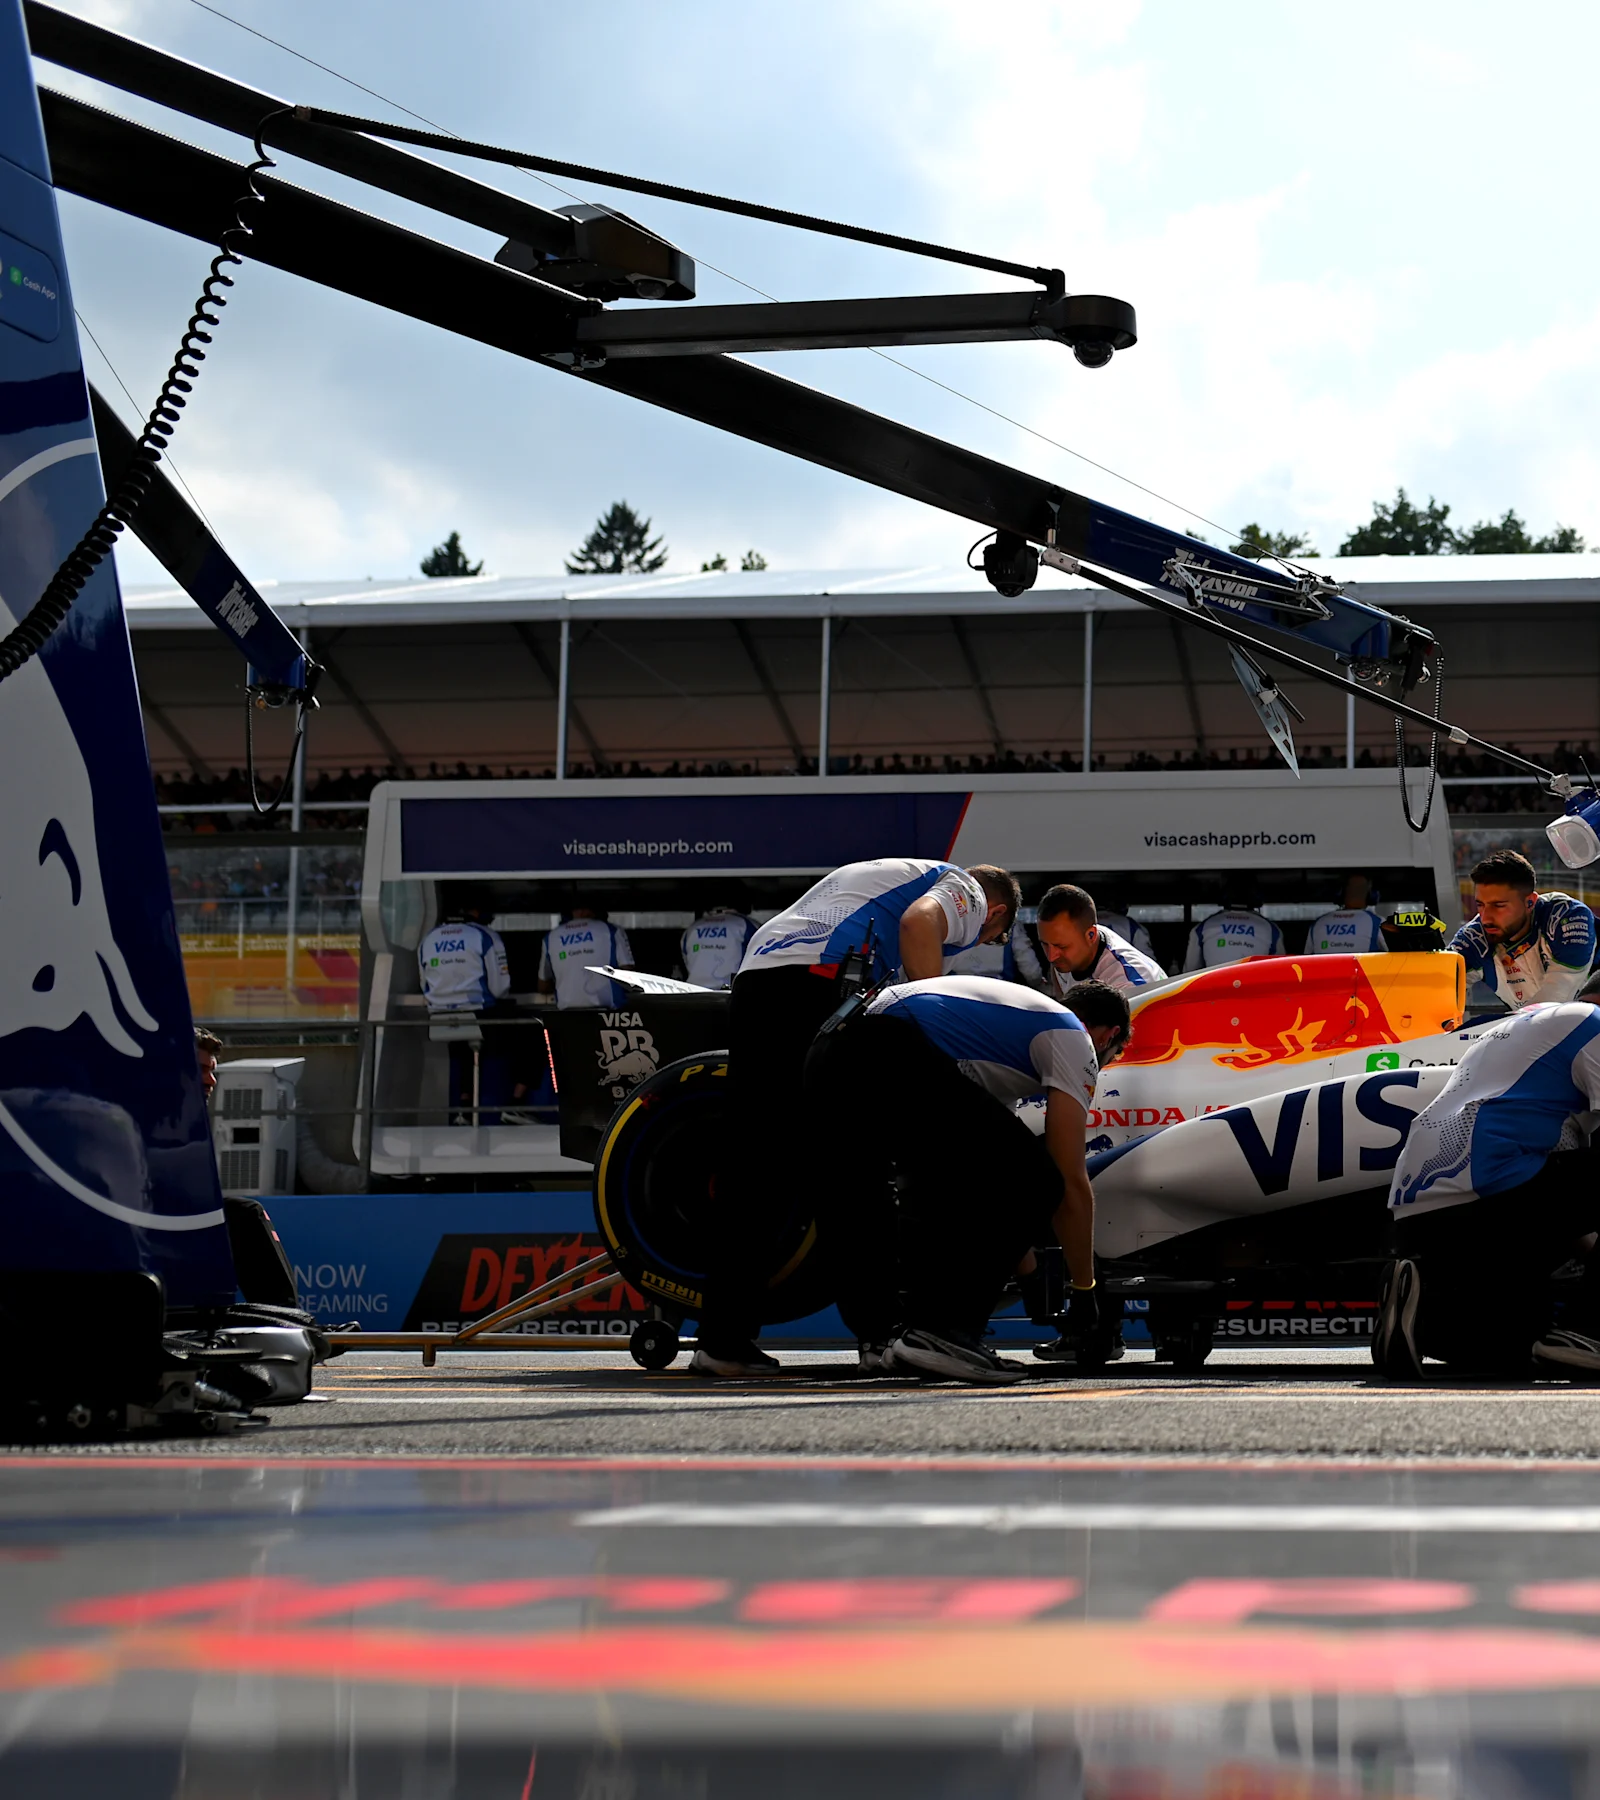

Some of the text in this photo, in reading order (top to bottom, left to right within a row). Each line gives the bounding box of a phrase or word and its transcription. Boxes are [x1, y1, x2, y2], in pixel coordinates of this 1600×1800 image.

[23, 276, 41, 292] Cash
[563, 839, 734, 857] visacashapprb.com
[1144, 832, 1316, 848] visacashapprb.com
[1396, 913, 1426, 925] LAW
[697, 927, 727, 938] VISA
[1221, 924, 1255, 937] VISA
[1325, 924, 1356, 935] VISA
[435, 940, 465, 953] VISA
[560, 931, 593, 946] VISA
[598, 1012, 643, 1027] VISA
[1086, 1106, 1187, 1128] ONDA
[1200, 1071, 1420, 1196] VIS
[293, 1264, 367, 1289] NOW
[640, 1270, 703, 1309] PIRELLI
[297, 1294, 389, 1313] REAMING
[1212, 1317, 1374, 1336] ESURRECTI
